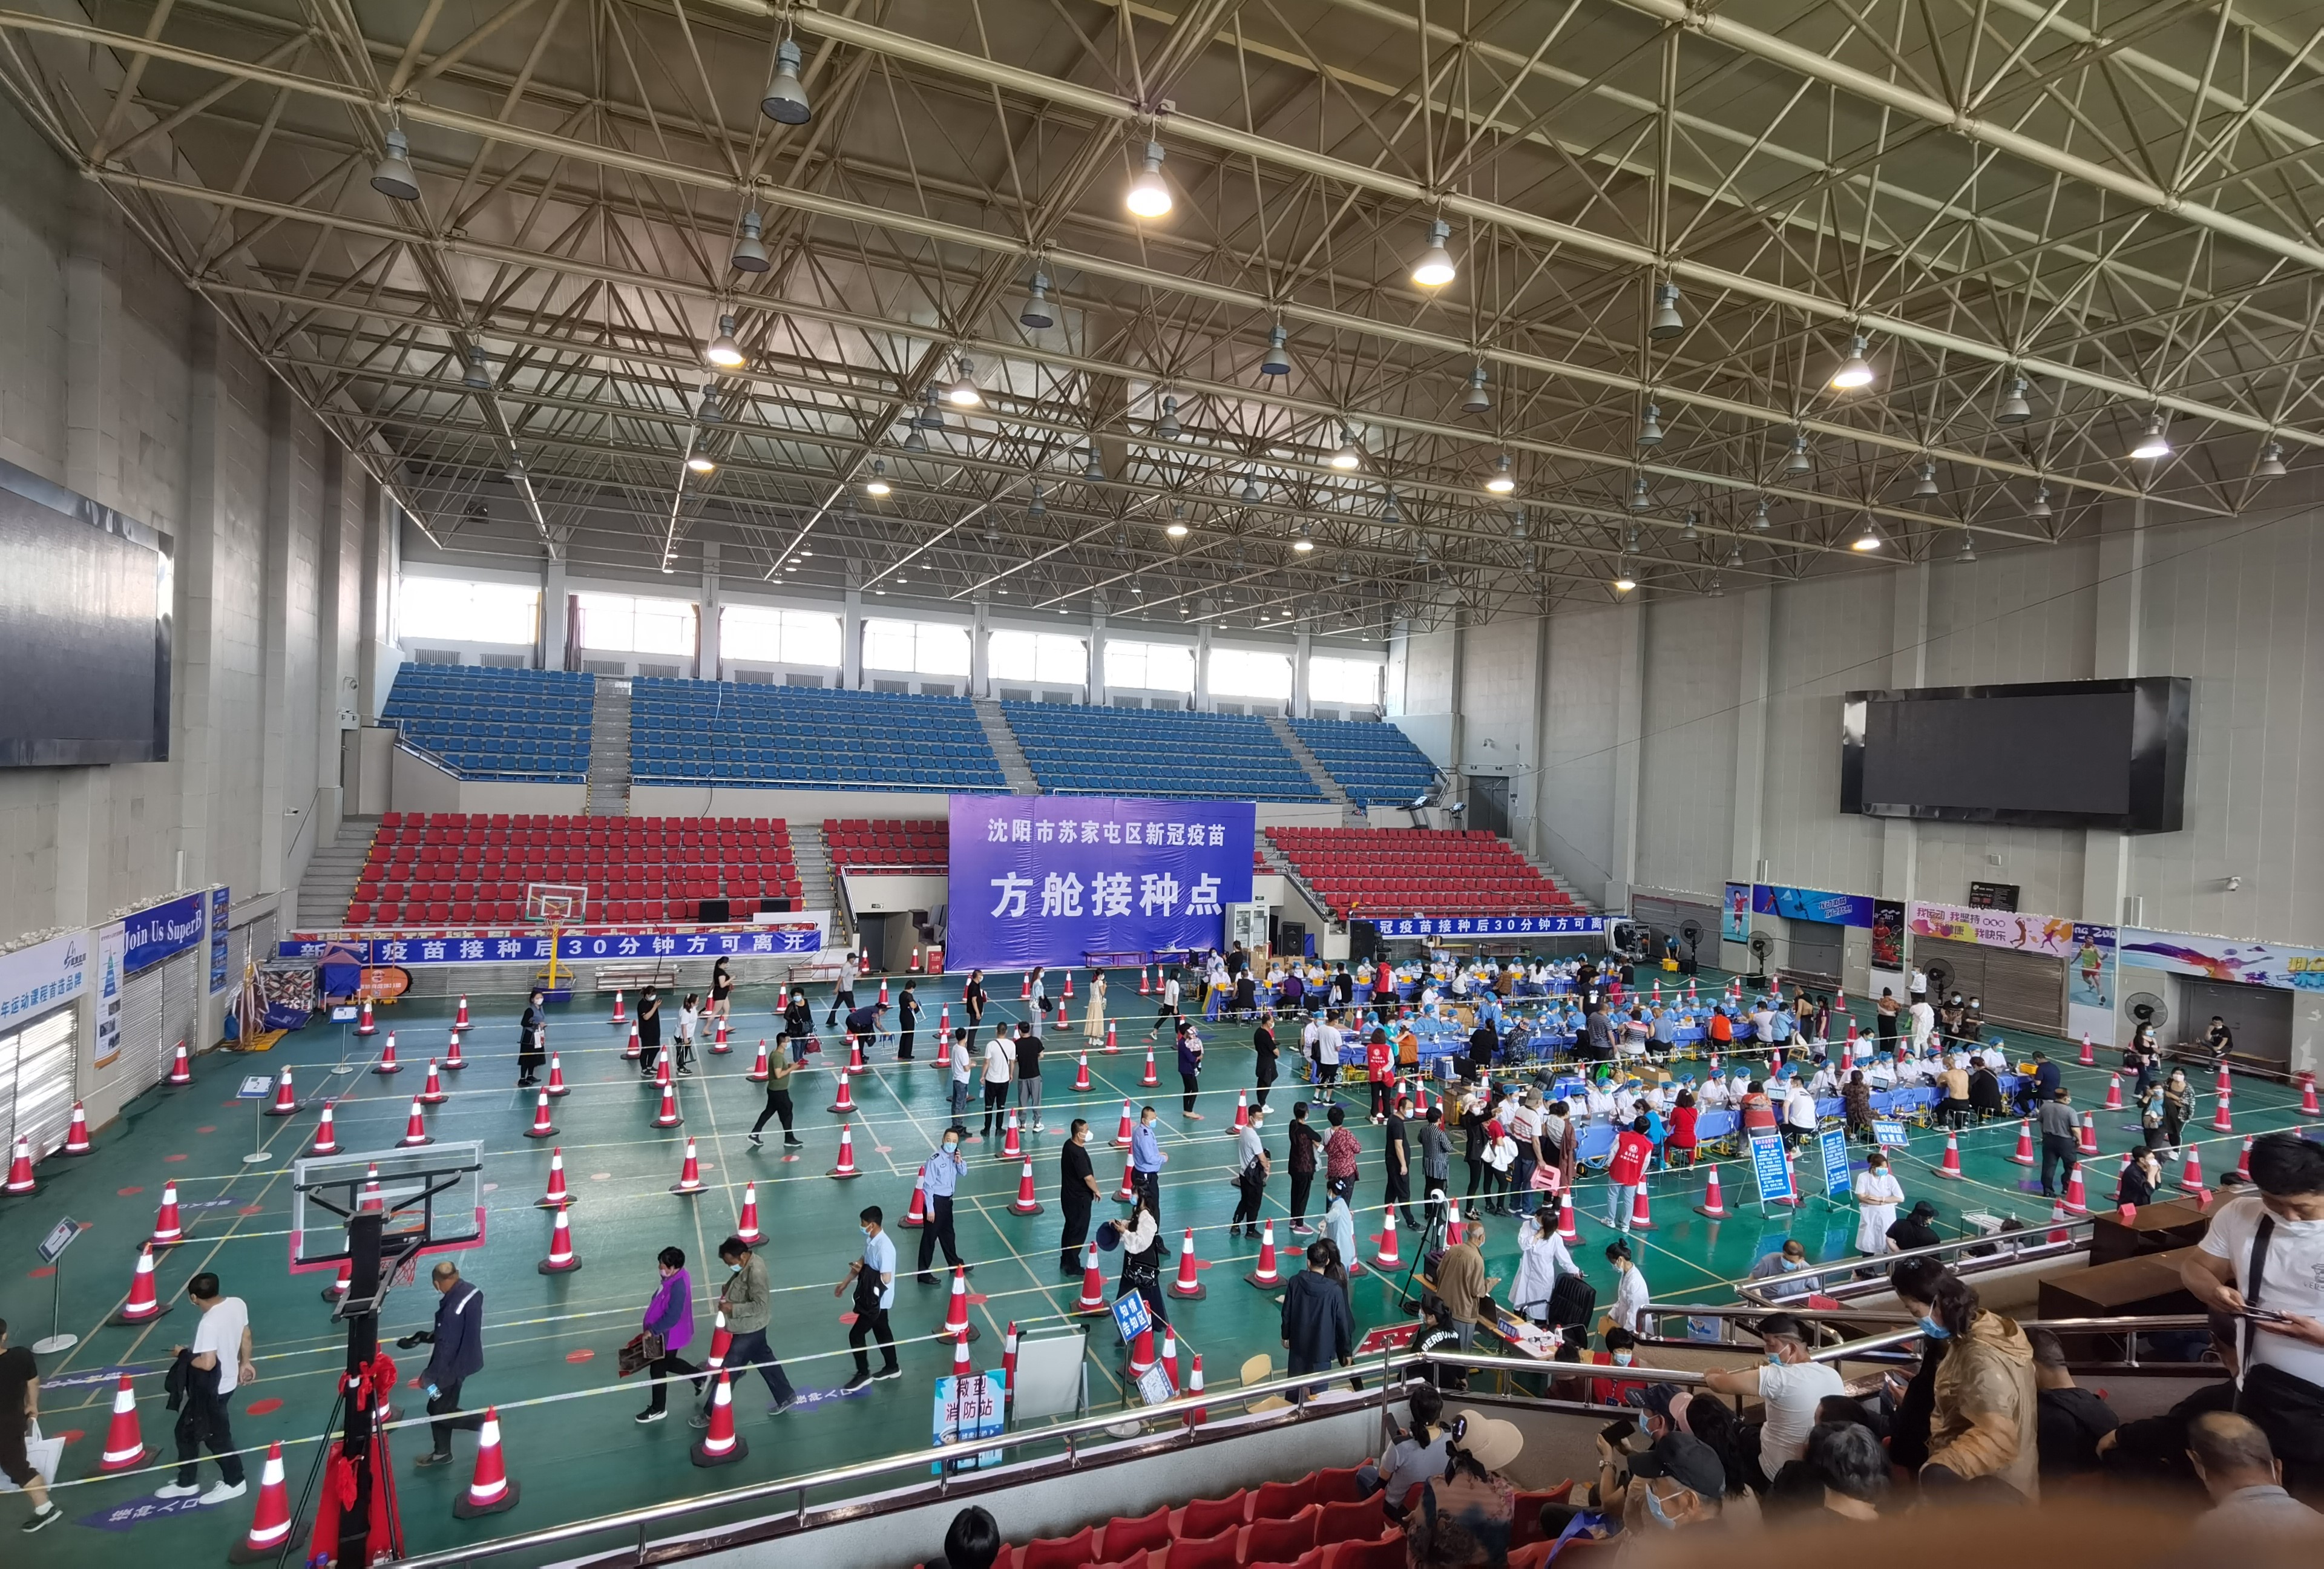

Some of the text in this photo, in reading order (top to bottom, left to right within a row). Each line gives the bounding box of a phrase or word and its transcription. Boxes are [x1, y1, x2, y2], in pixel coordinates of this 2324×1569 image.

[988, 818, 1226, 846] 沈阳市苏家屯区新冠疫苗
[991, 872, 1223, 917] 方舱接种点
[1369, 917, 1603, 933] 冠疫苗接种后30分钟方可离
[1950, 912, 1980, 924] 我坚持
[124, 909, 202, 956] Join Us SuperB
[301, 934, 804, 961] 新疫苗接种后30分钟方可离开
[1, 971, 82, 1018] 年运动课程首选品牌
[1119, 1298, 1138, 1320] 知情
[1122, 1310, 1147, 1337] 告知区
[956, 1377, 987, 1399] 微型
[946, 1398, 993, 1421] 消防站
